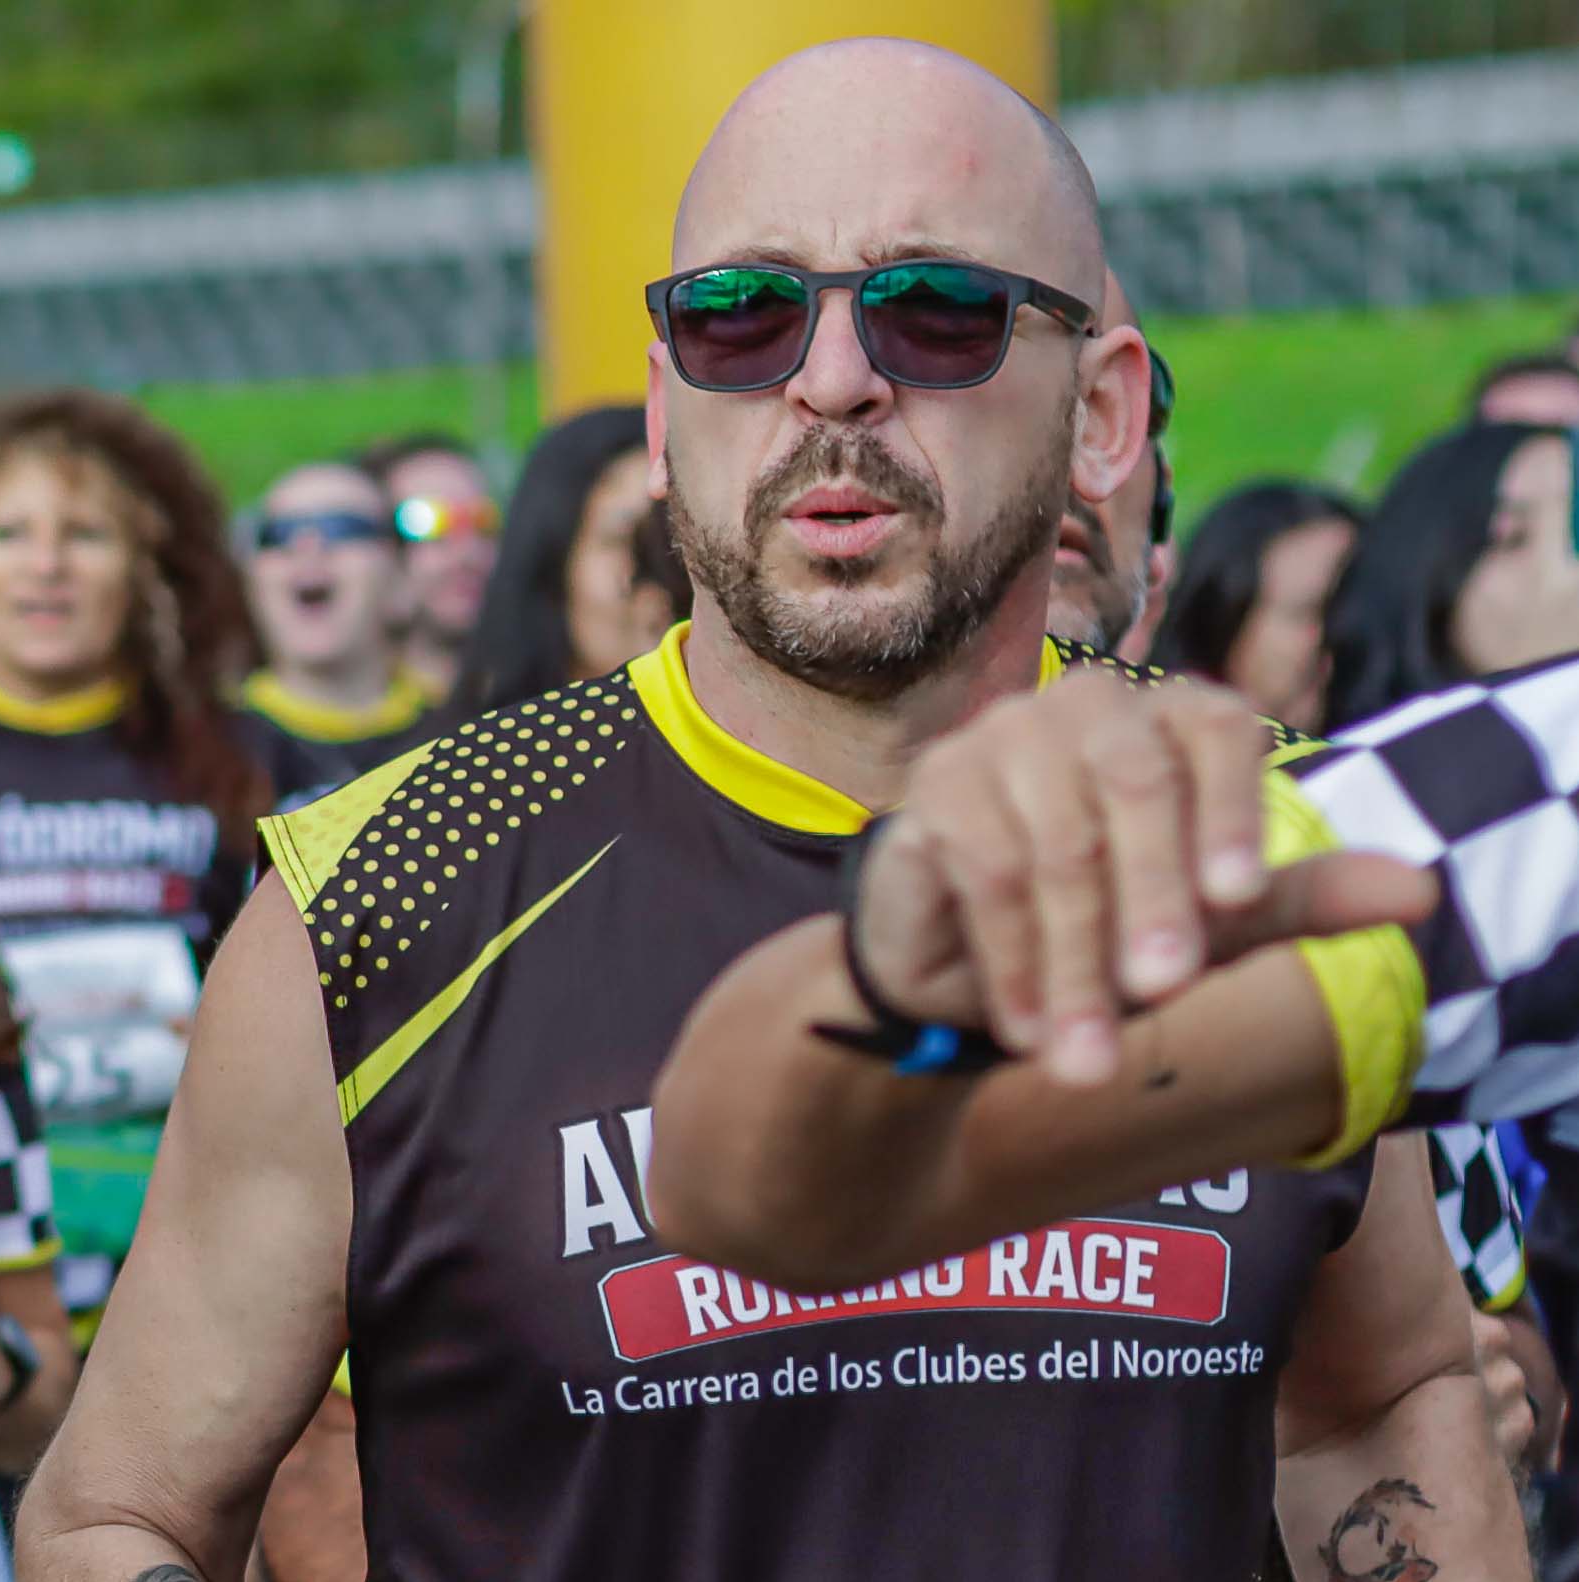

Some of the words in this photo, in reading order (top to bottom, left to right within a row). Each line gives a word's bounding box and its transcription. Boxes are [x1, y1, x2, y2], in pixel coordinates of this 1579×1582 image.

[675, 1255, 962, 1337] RUNG
[988, 1230, 1160, 1308] RACE
[562, 1380, 604, 1414] La
[615, 1375, 759, 1410] Carrera
[772, 1358, 818, 1395] de
[830, 1353, 883, 1390] los
[892, 1344, 1026, 1385] Clubes
[1039, 1340, 1100, 1380] del
[1113, 1340, 1263, 1378] Noroeste
